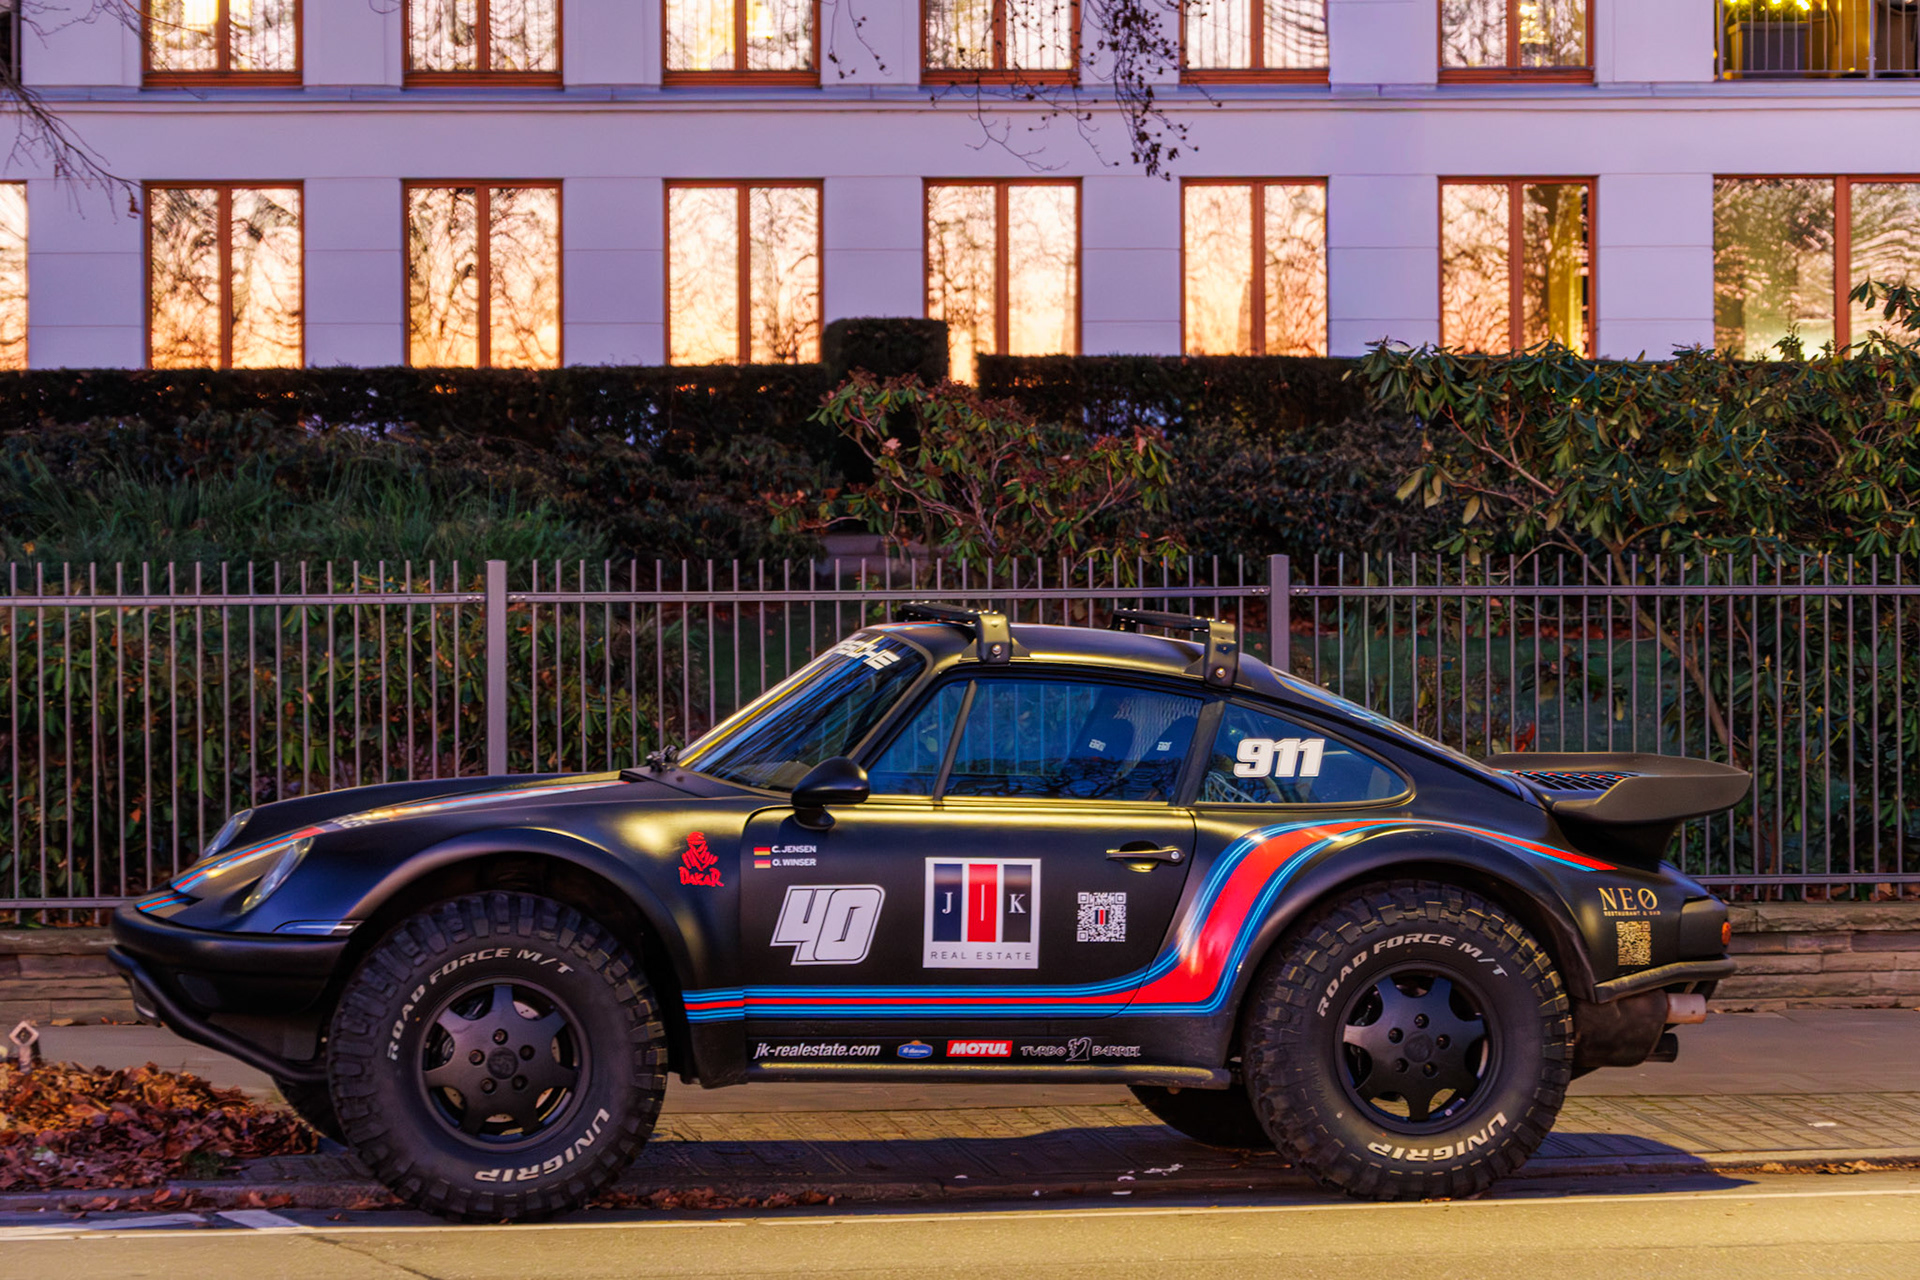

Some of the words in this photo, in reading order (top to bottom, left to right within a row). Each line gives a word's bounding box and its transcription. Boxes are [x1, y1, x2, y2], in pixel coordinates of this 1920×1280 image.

[1233, 738, 1326, 779] 911
[678, 866, 724, 887] DAKAR
[770, 884, 886, 966] 40
[930, 951, 967, 960] REAL
[976, 951, 1032, 960] ESTATE
[1316, 950, 1368, 1017] ROAD
[1373, 933, 1456, 955] FORCE
[1458, 942, 1508, 977] M/T
[386, 984, 427, 1061] ROAD
[429, 947, 512, 985] FORCE
[516, 949, 574, 975] M/T
[753, 1043, 881, 1059] jk-realestate.com
[950, 1043, 1009, 1055] MOTUL
[1020, 1045, 1067, 1057] TURBO
[1092, 1045, 1141, 1057] BARREL
[474, 1108, 611, 1182] UNIGRIP
[1367, 1112, 1508, 1161] UNIGRIP
